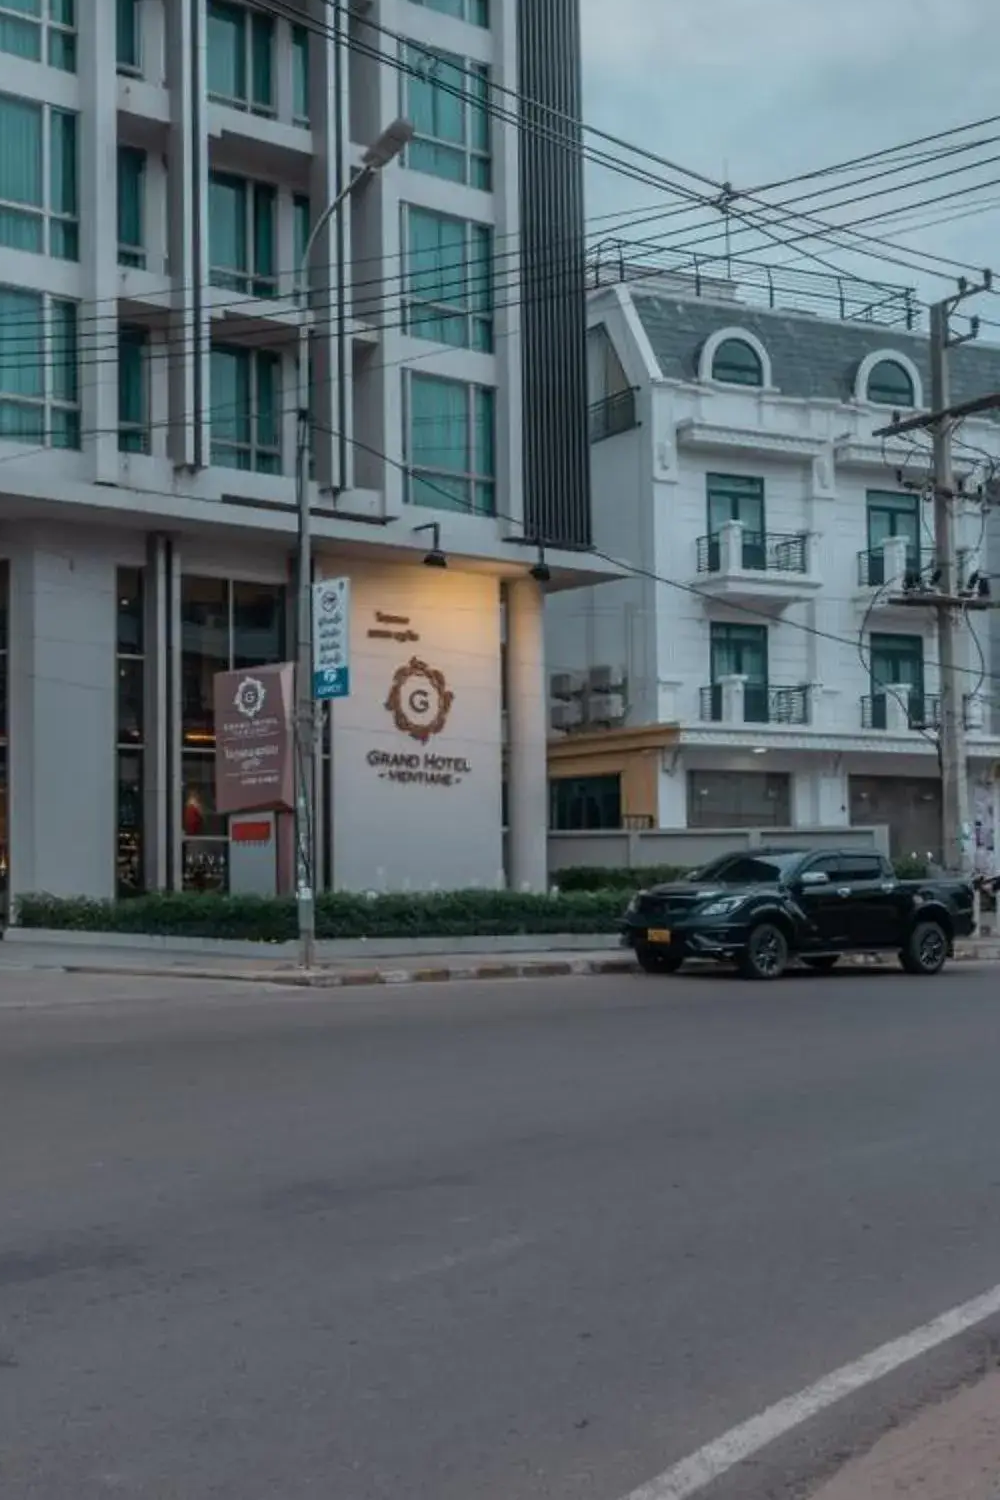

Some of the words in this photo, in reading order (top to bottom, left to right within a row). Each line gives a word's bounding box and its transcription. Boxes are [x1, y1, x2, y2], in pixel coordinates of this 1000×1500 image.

[409, 689, 429, 713] G
[366, 749, 420, 769] GRAND
[423, 753, 472, 773] HOTEL
